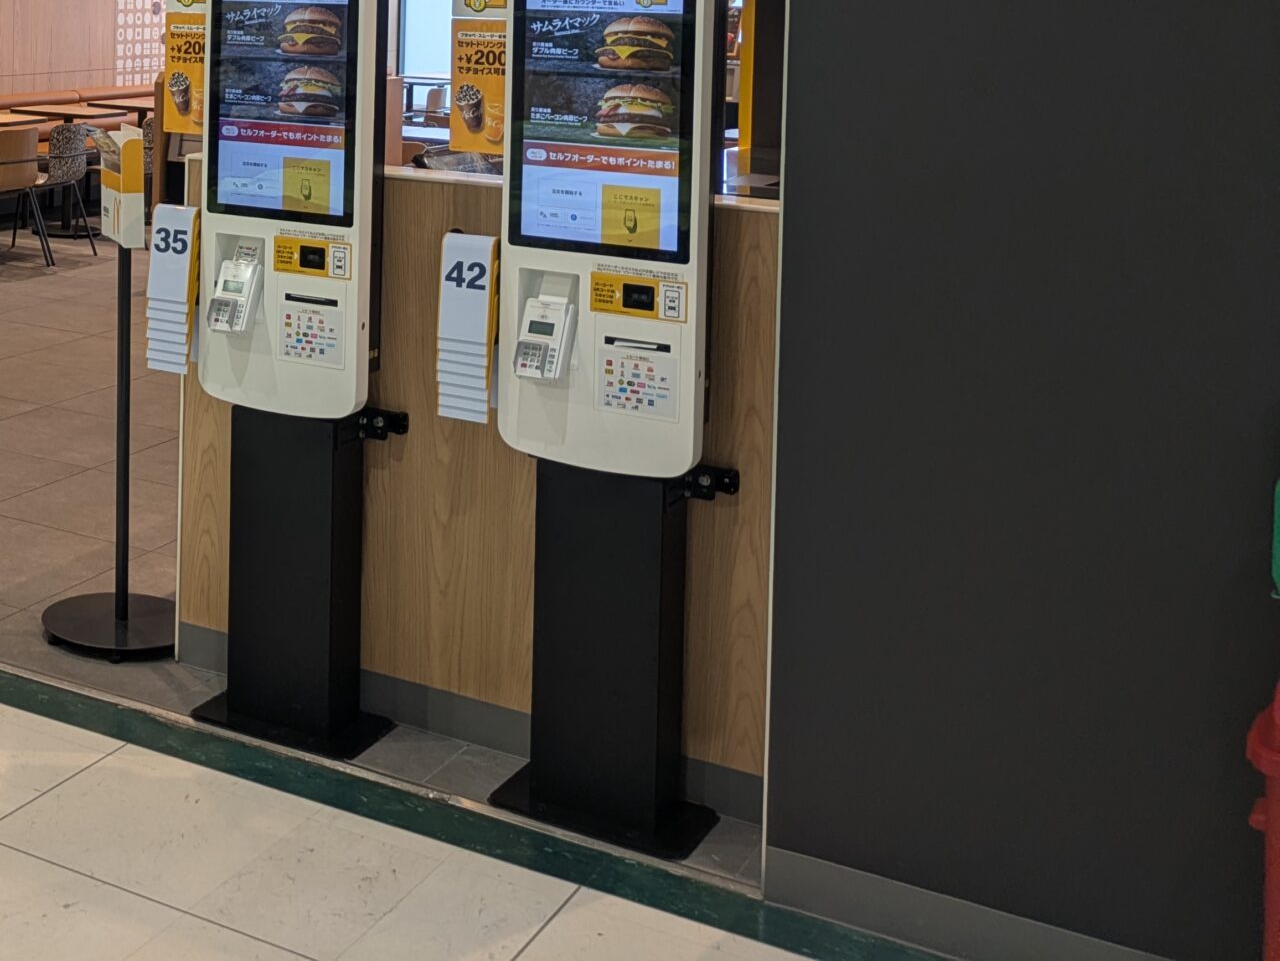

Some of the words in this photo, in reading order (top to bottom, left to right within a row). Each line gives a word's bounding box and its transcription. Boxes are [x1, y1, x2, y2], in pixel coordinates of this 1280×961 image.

[225, 4, 282, 23] サムライマック
[530, 13, 600, 35] サムライマック
[154, 227, 188, 255] 35
[444, 261, 487, 291] 42
